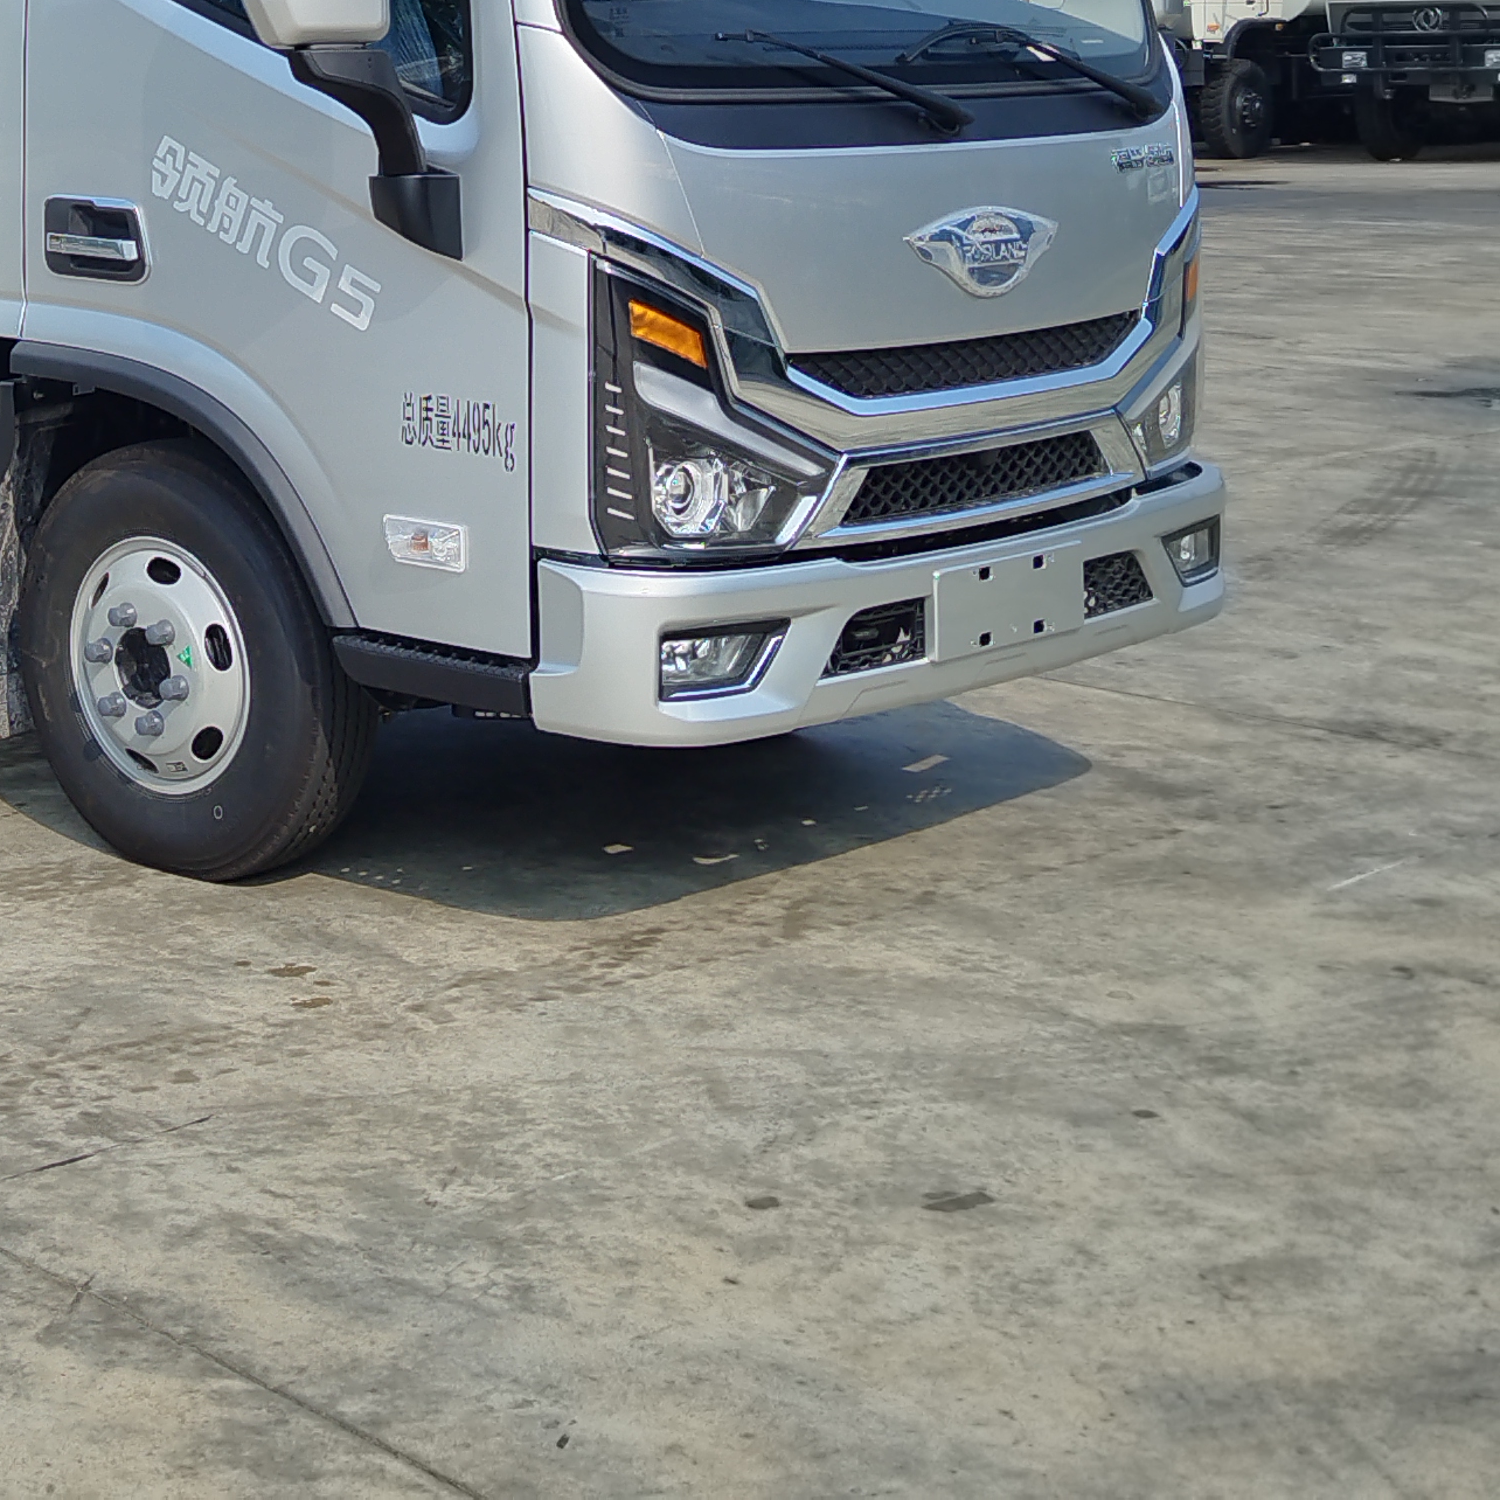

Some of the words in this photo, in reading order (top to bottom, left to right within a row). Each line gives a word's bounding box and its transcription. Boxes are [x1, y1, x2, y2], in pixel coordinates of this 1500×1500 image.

[152, 135, 382, 332] 领航G5
[401, 392, 516, 472] 总质量4495kg
